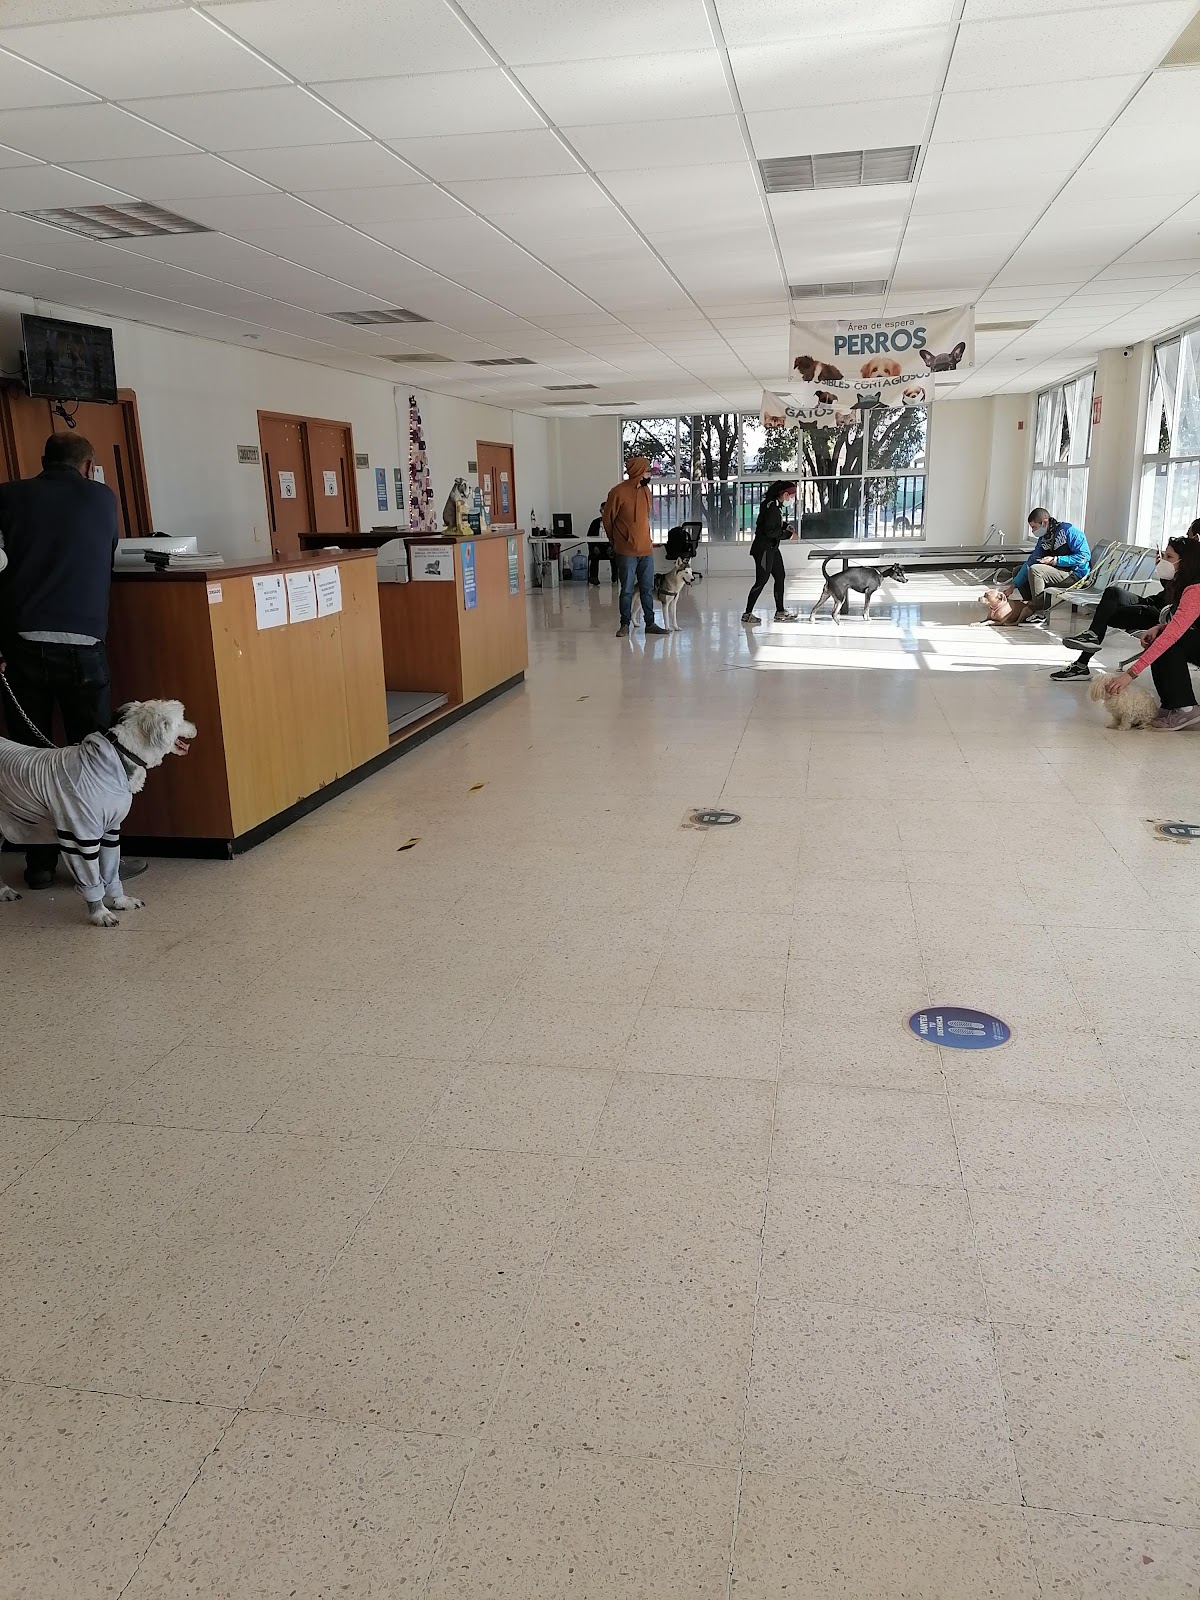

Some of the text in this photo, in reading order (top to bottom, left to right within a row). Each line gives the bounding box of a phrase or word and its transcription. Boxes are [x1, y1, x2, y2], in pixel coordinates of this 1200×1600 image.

[848, 319, 915, 331] Área de espera
[834, 327, 927, 355] PERROS
[807, 379, 850, 389] SIBLES
[785, 406, 834, 418] GATOS
[918, 1015, 928, 1034] MANTÉN
